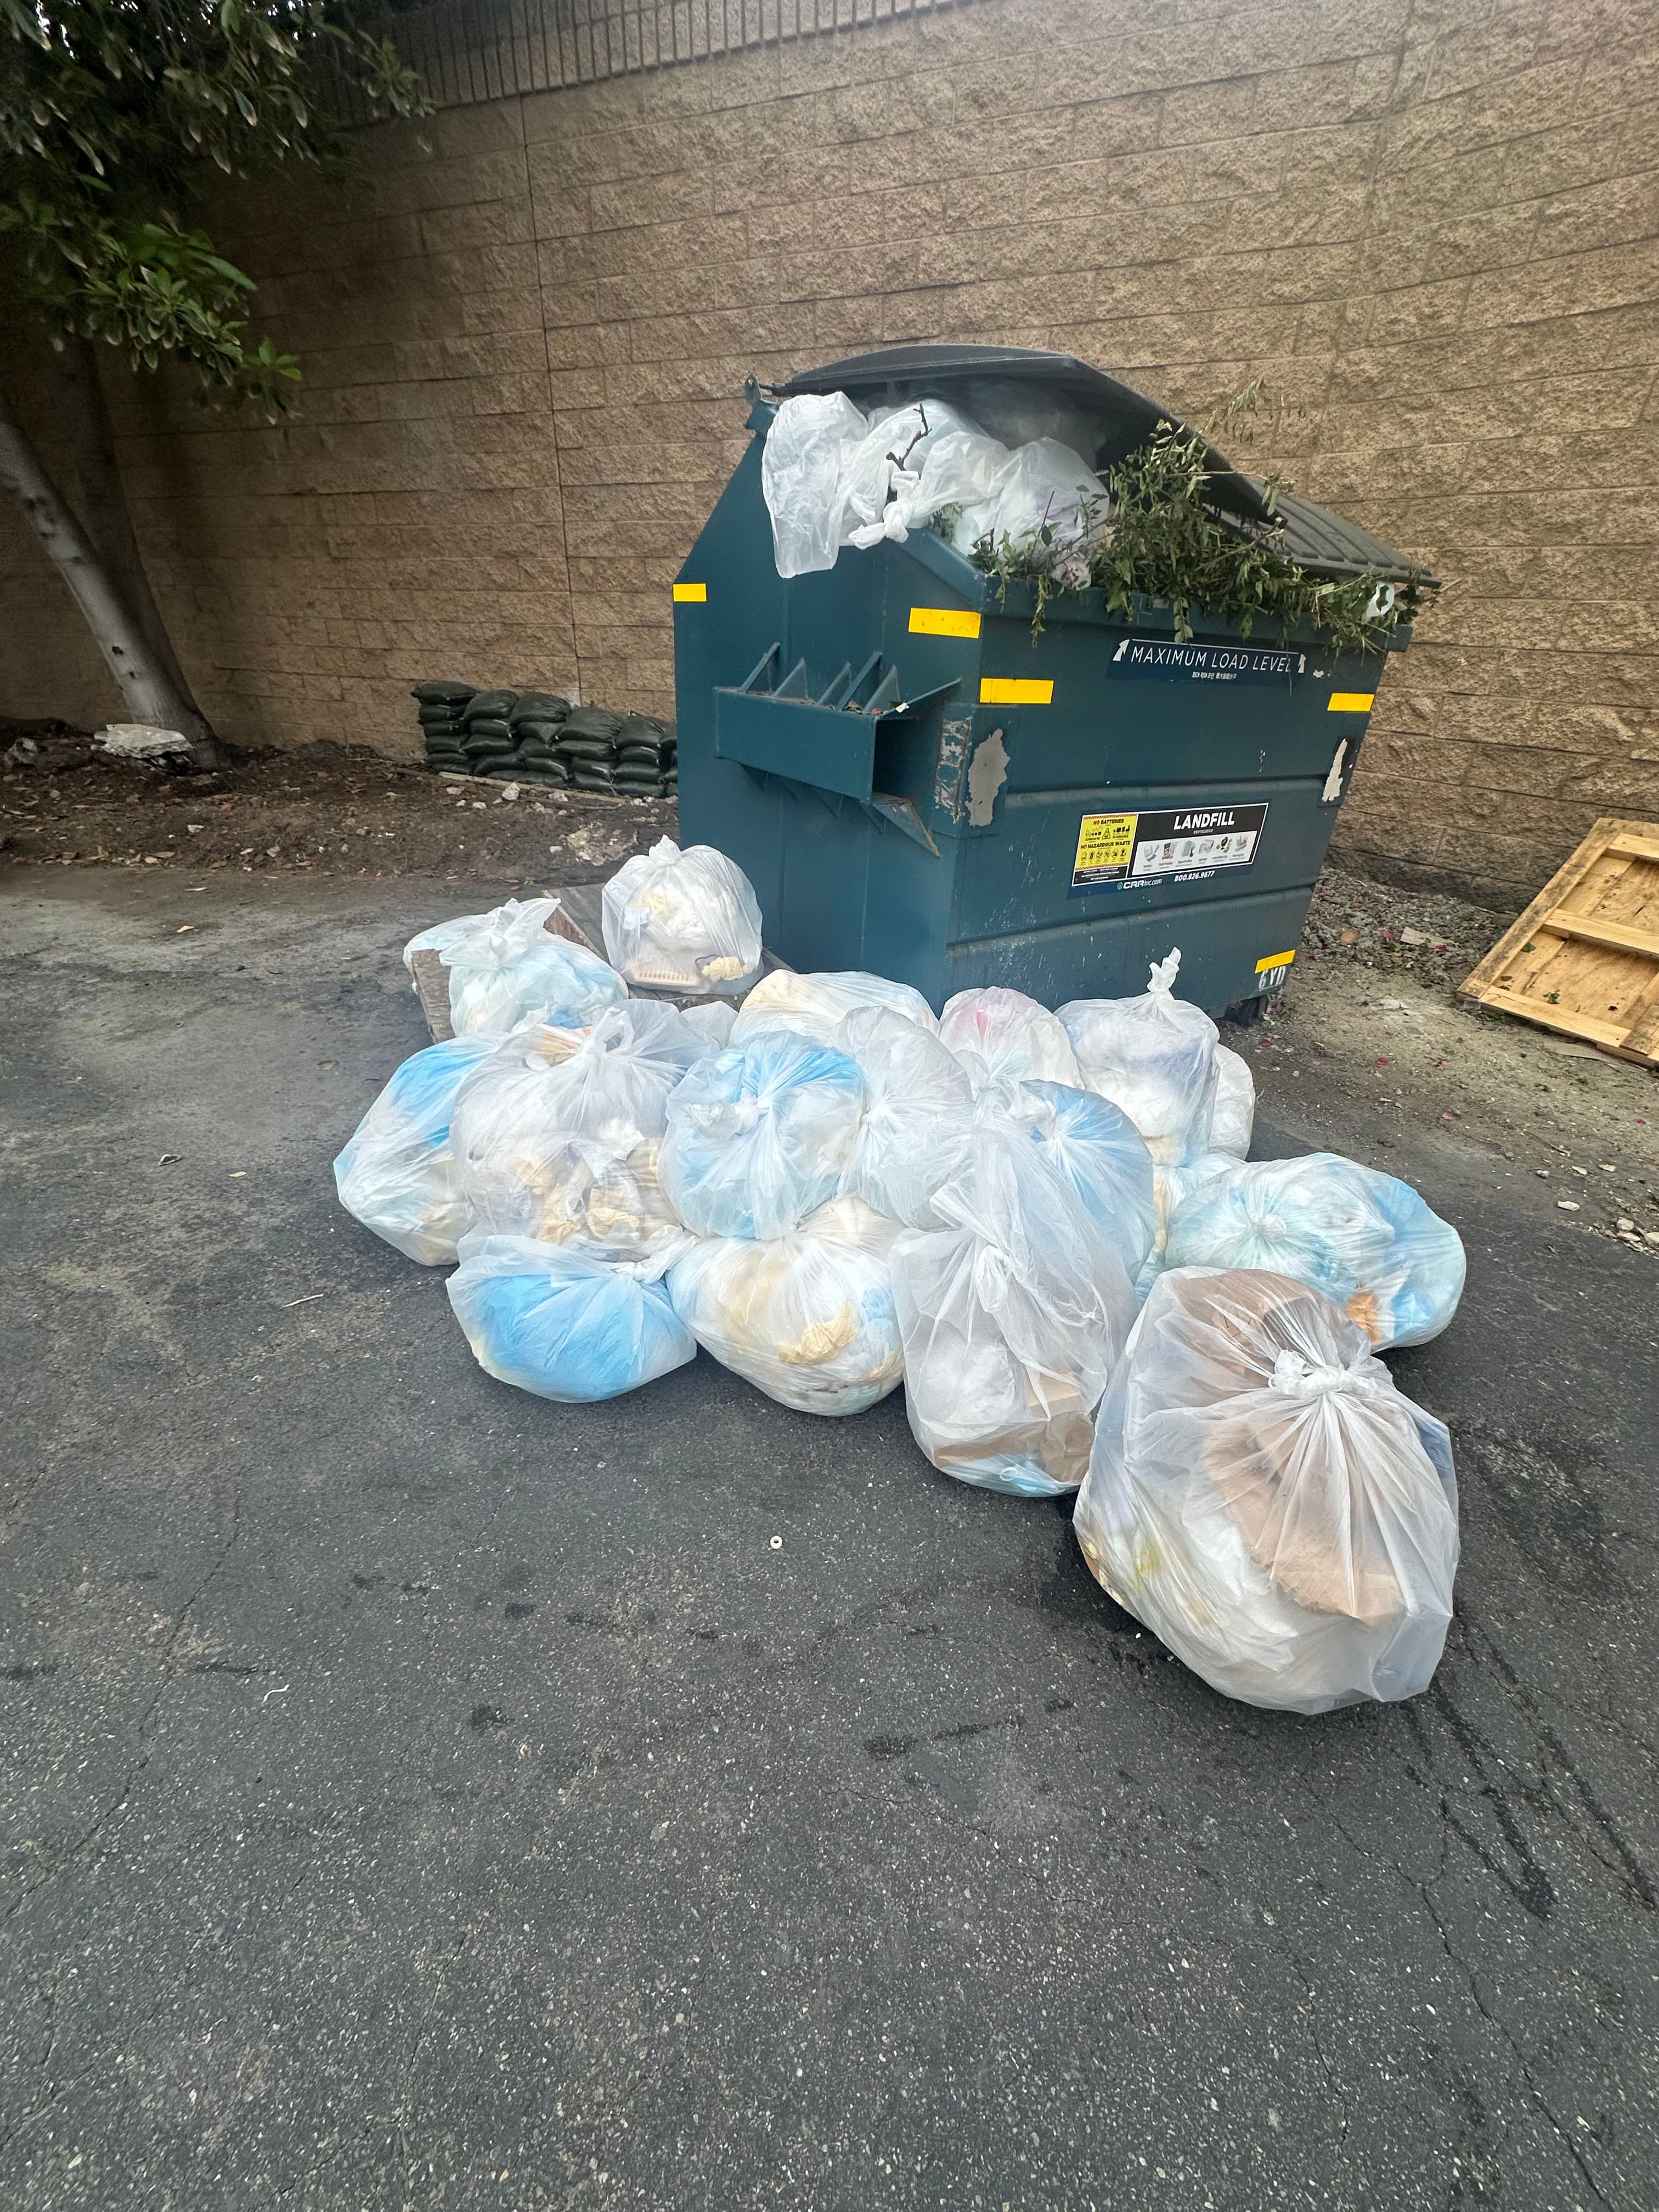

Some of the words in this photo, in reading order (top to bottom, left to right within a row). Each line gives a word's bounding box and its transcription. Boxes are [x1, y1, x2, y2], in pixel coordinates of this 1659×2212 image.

[1131, 646, 1207, 667] MAXIMUM
[1212, 653, 1248, 669] LOAD
[1252, 656, 1291, 672] LEVEL
[1173, 811, 1235, 830] LANDFILL
